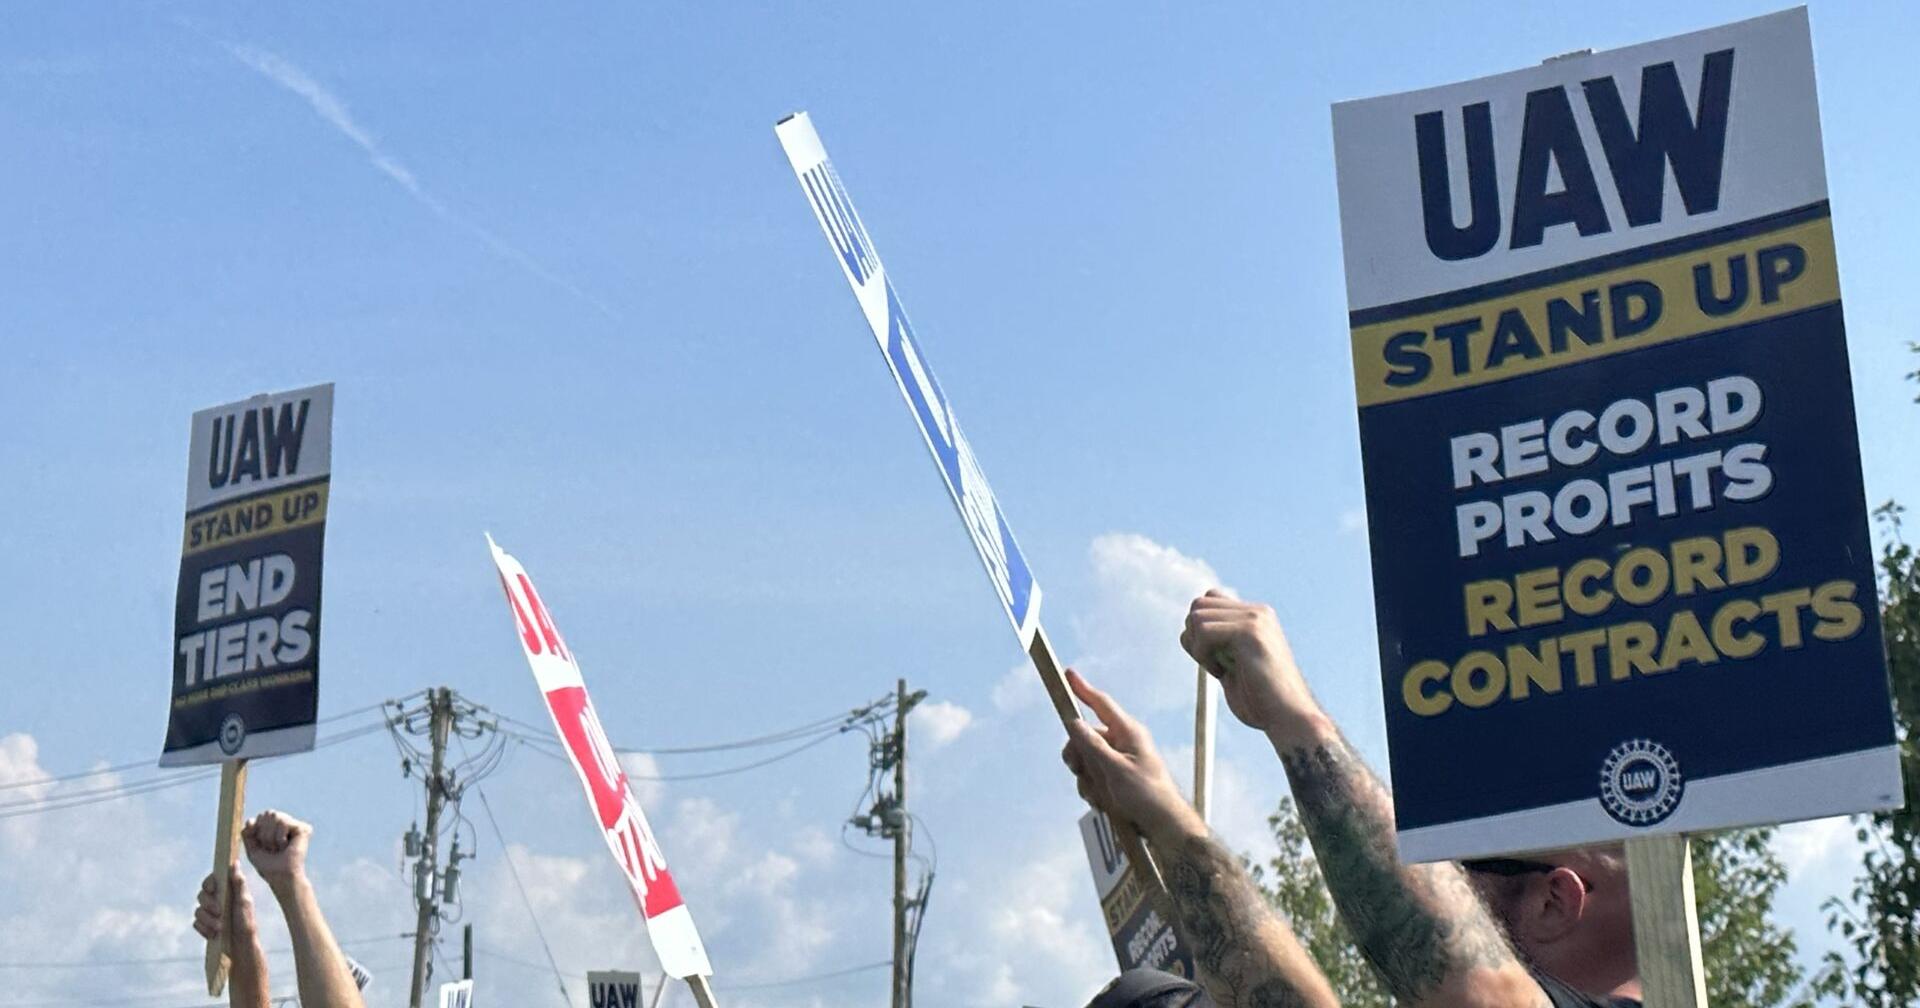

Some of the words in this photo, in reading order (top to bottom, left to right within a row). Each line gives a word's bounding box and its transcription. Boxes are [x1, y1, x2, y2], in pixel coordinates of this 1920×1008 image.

[1415, 48, 1735, 262] UAW
[1383, 280, 1663, 387] STAND
[1693, 244, 1808, 317] UP
[209, 399, 311, 489] UAW
[1451, 375, 1764, 489] RECORD
[190, 504, 272, 547] STAND
[282, 490, 320, 523] UP
[1456, 443, 1774, 557] PROFITS
[197, 554, 295, 622] END
[1464, 526, 1781, 637] RECORD
[180, 609, 311, 686] TIERS
[1402, 580, 1864, 716] CONTRACTS
[1622, 770, 1656, 790] UAW
[591, 982, 638, 1008] UAW
